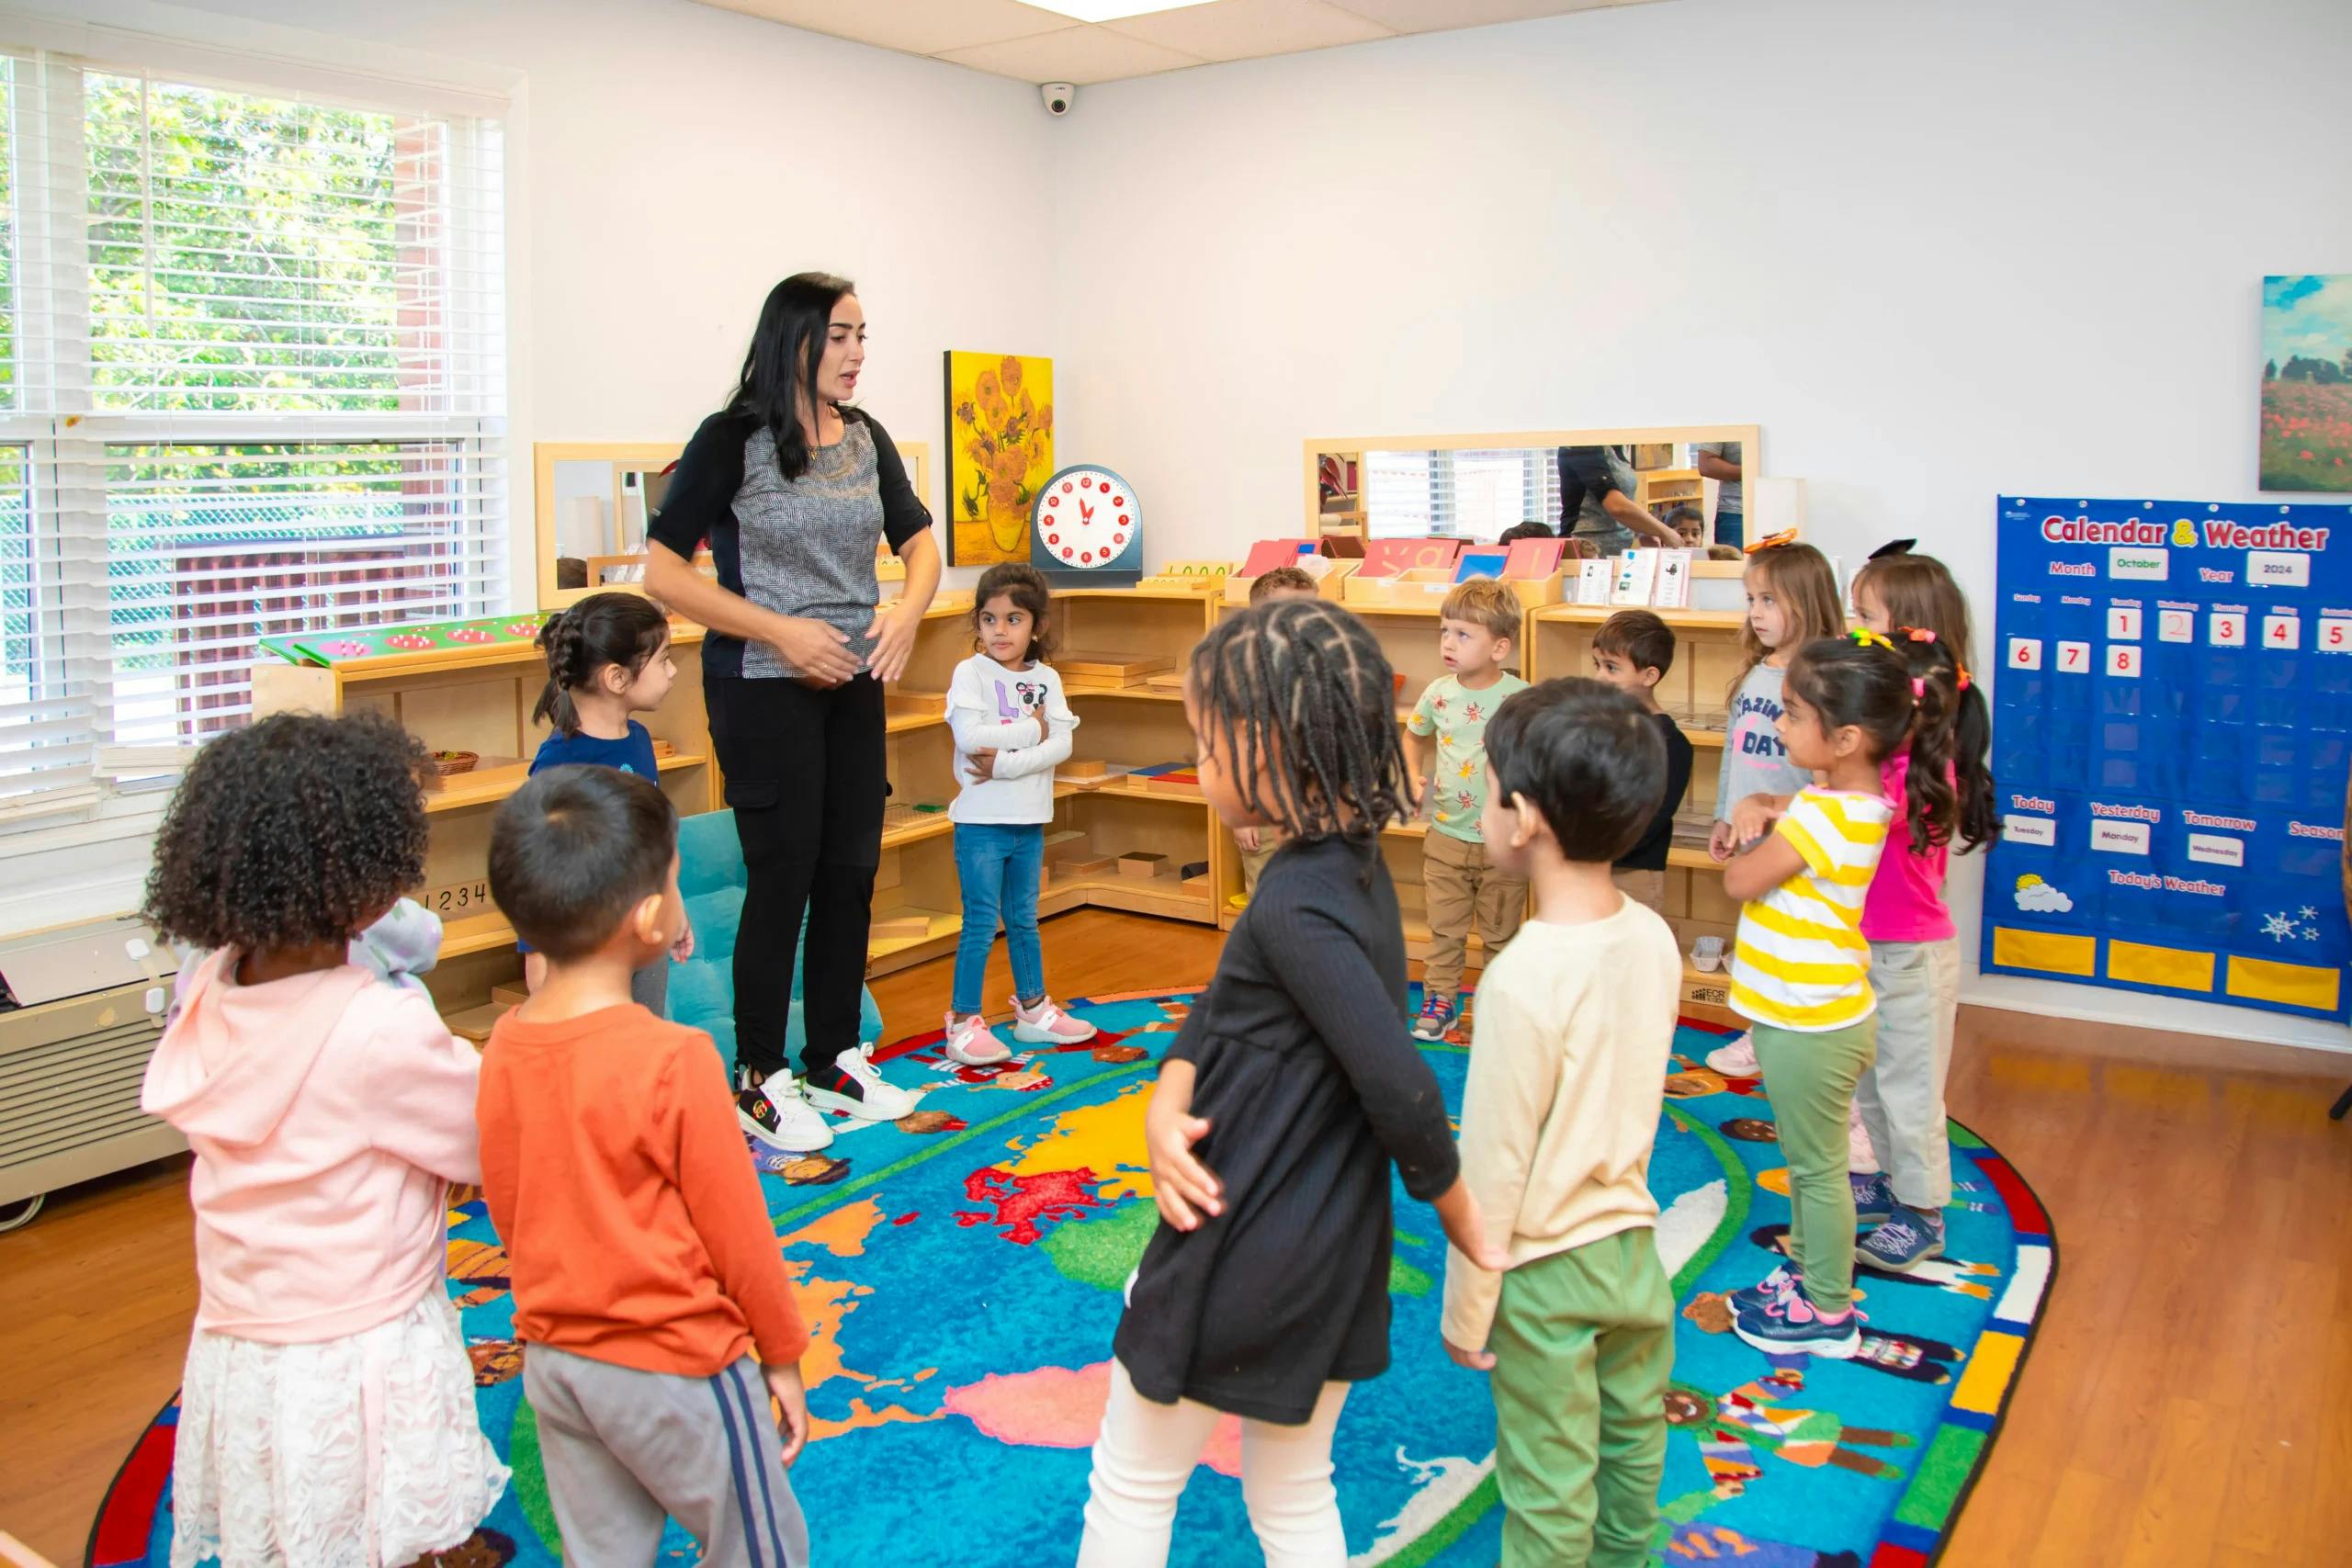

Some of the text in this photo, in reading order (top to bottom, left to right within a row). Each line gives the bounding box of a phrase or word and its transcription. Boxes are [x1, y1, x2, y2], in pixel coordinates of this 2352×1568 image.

[2042, 515, 2329, 551] Calendar & Weather
[2049, 561, 2096, 577] Month
[2117, 558, 2161, 569] October
[2264, 564, 2292, 574] 2024
[2199, 567, 2233, 583] Year
[2120, 614, 2344, 644] 1 2 3 4 5
[2018, 646, 2130, 670] 6 7 8
[1742, 731, 1785, 756] DAY
[2011, 795, 2054, 814] Today
[2090, 802, 2160, 823] Yesterday
[2182, 810, 2256, 831] Tomorrow
[2014, 826, 2043, 836] Tuesday
[2101, 831, 2139, 843] Monday
[2193, 844, 2238, 858] Wednesday
[2109, 870, 2226, 897] Today's Weather
